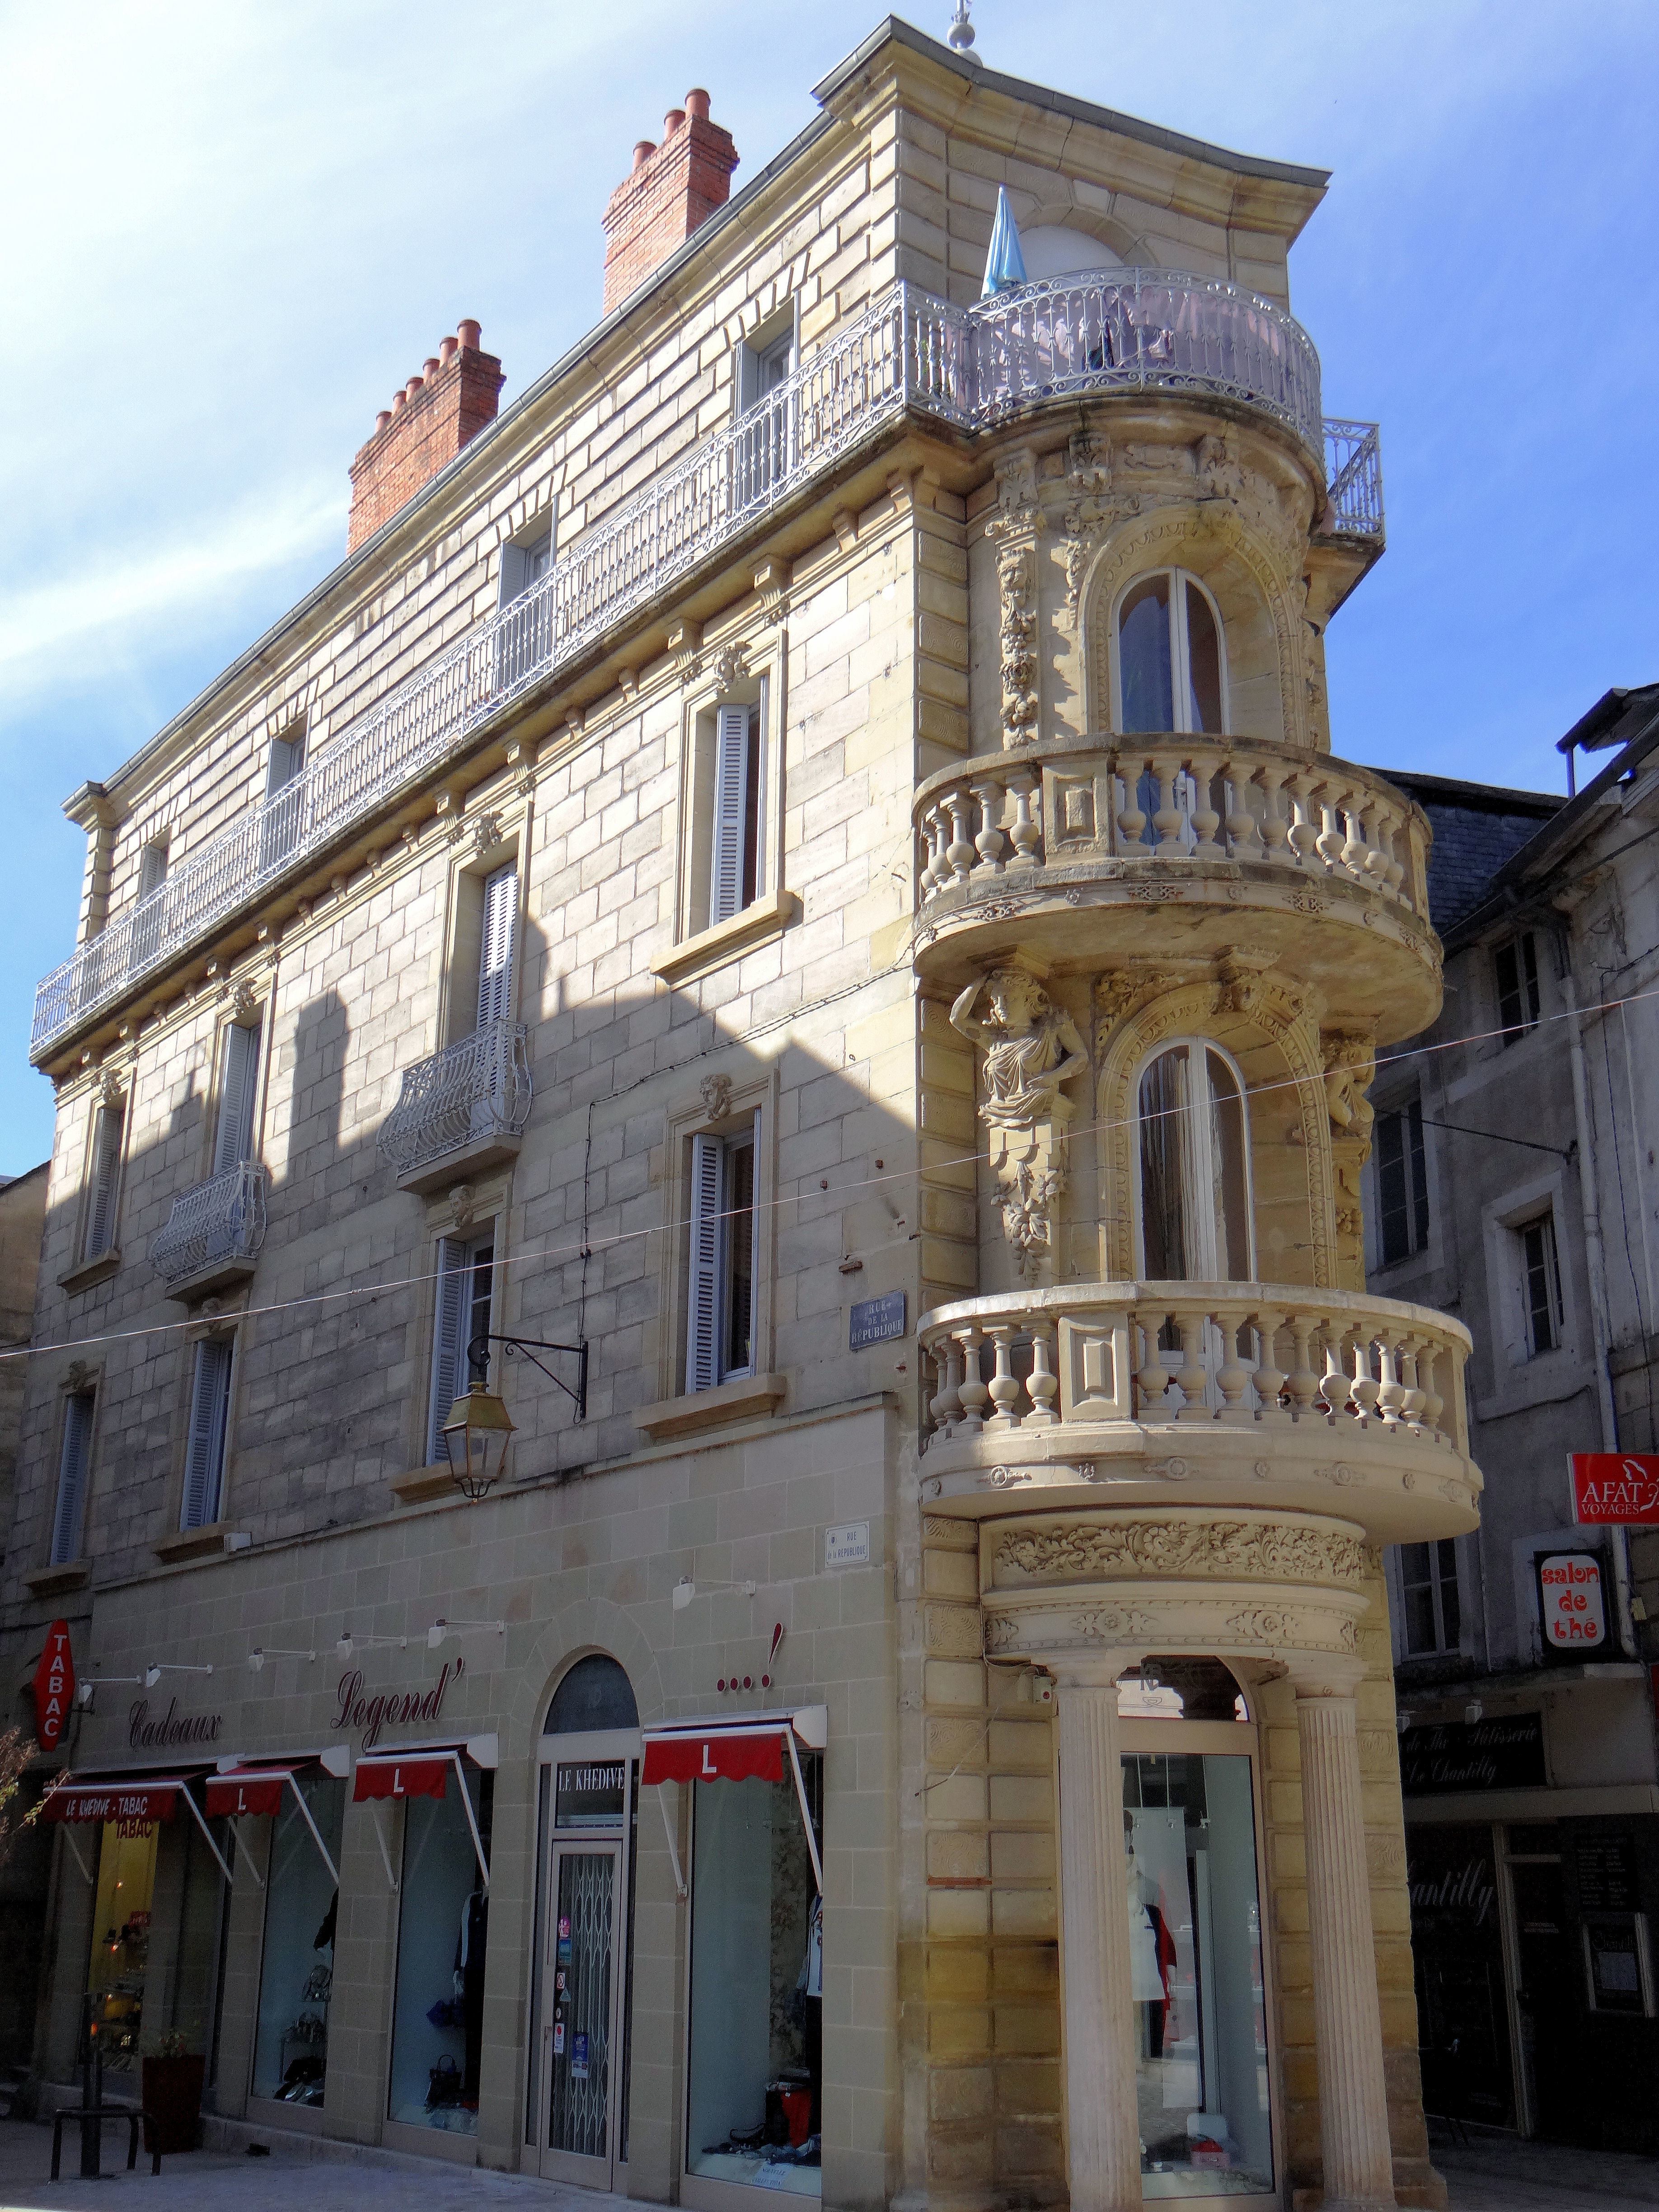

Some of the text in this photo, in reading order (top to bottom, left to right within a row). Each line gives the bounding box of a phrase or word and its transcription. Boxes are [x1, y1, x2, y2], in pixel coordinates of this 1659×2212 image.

[868, 1300, 886, 1314] RUE
[867, 1312, 888, 1326] DE LA
[1582, 1482, 1644, 1503] AFAT
[1581, 1504, 1639, 1514] VOYAGES
[847, 1531, 857, 1542] RUE
[1542, 1561, 1600, 1584] salon
[1559, 1589, 1588, 1612] de
[1552, 1617, 1598, 1640] thé
[44, 1634, 67, 1737] TABAC
[129, 1696, 222, 1748] Cadeaux
[702, 1744, 717, 1774] L
[394, 1768, 404, 1793] L
[558, 1767, 624, 1792] LE KHEDIVE
[66, 1799, 76, 1817] LE
[118, 1796, 148, 1816] TABAC
[238, 1788, 246, 1810] L
